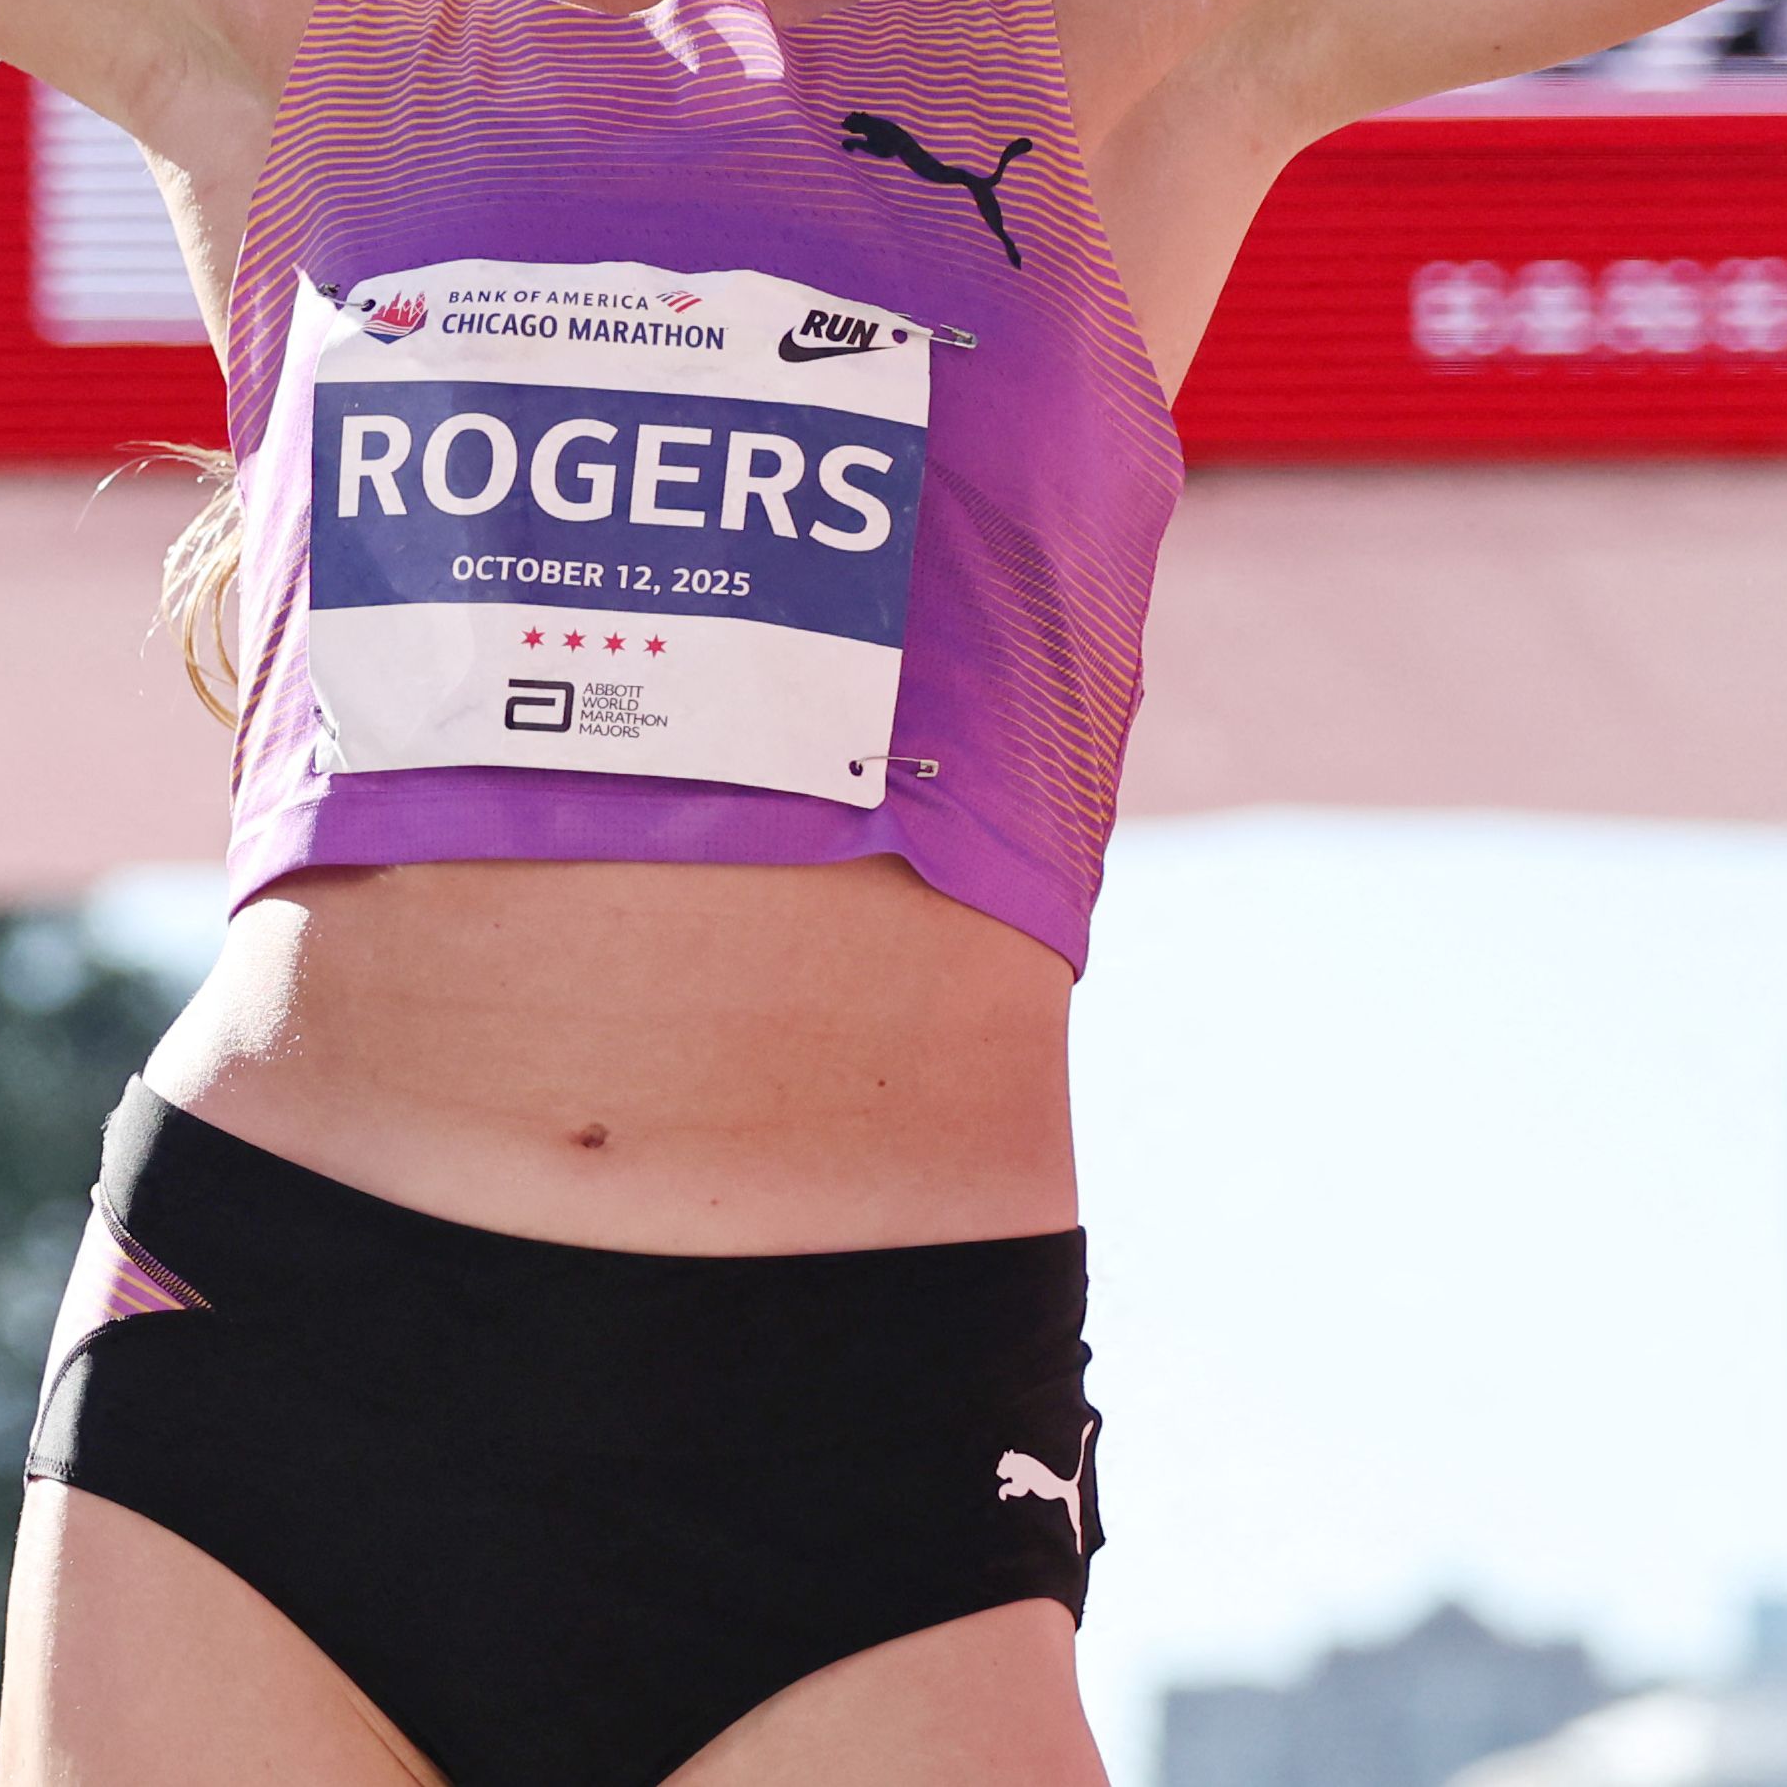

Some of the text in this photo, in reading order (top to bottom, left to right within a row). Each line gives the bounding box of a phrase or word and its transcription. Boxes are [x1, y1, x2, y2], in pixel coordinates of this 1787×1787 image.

[448, 290, 649, 311] BANK OF AMERICA
[442, 312, 726, 350] CHICAGO MARATHON
[799, 309, 880, 348] RUN
[336, 411, 895, 553] ROGERS
[451, 555, 751, 597] OCTOBER 12, 2025
[583, 682, 644, 698] ABBOTT
[582, 696, 639, 711] WORLD
[580, 710, 668, 727] MARATHON
[579, 723, 640, 739] MAJORS
